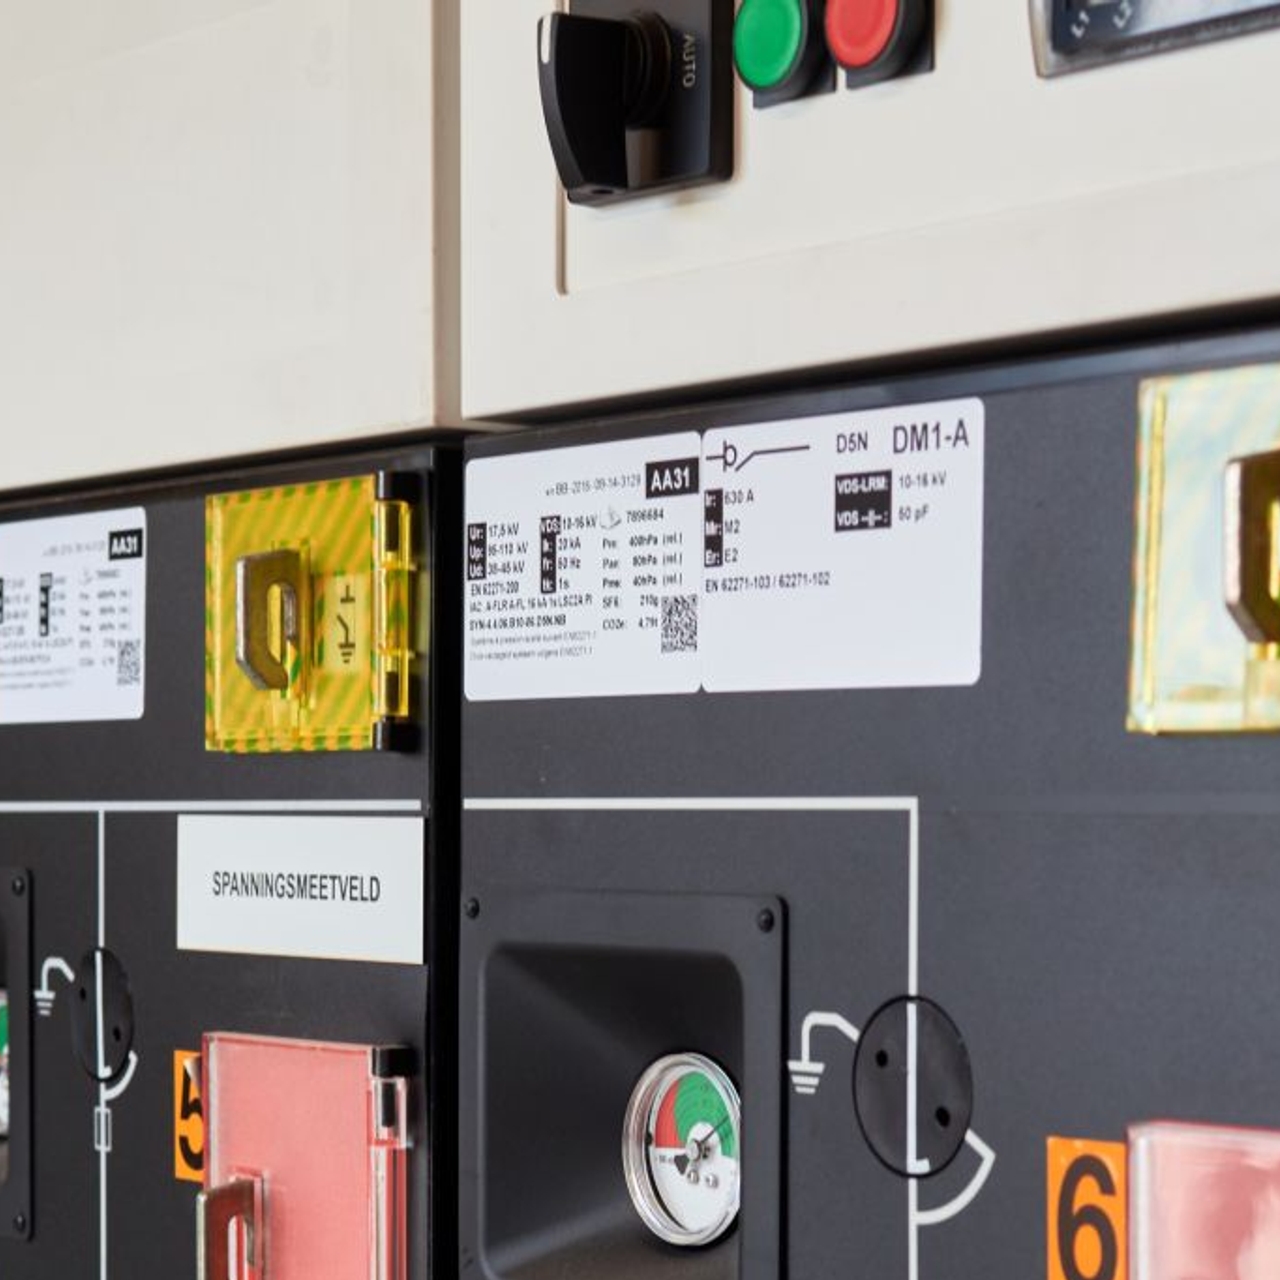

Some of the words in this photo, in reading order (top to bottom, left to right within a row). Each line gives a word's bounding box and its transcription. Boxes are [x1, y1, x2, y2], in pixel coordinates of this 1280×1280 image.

[683, 32, 695, 87] AUTO
[892, 418, 969, 454] DM1-A
[651, 466, 690, 492] AA31
[724, 490, 744, 505] 630
[747, 489, 754, 502] A
[724, 519, 740, 534] M2
[724, 548, 738, 563] E2
[705, 579, 718, 593] EN
[212, 870, 381, 902] SPANNINGSMEETVELD
[178, 1058, 205, 1171] 5
